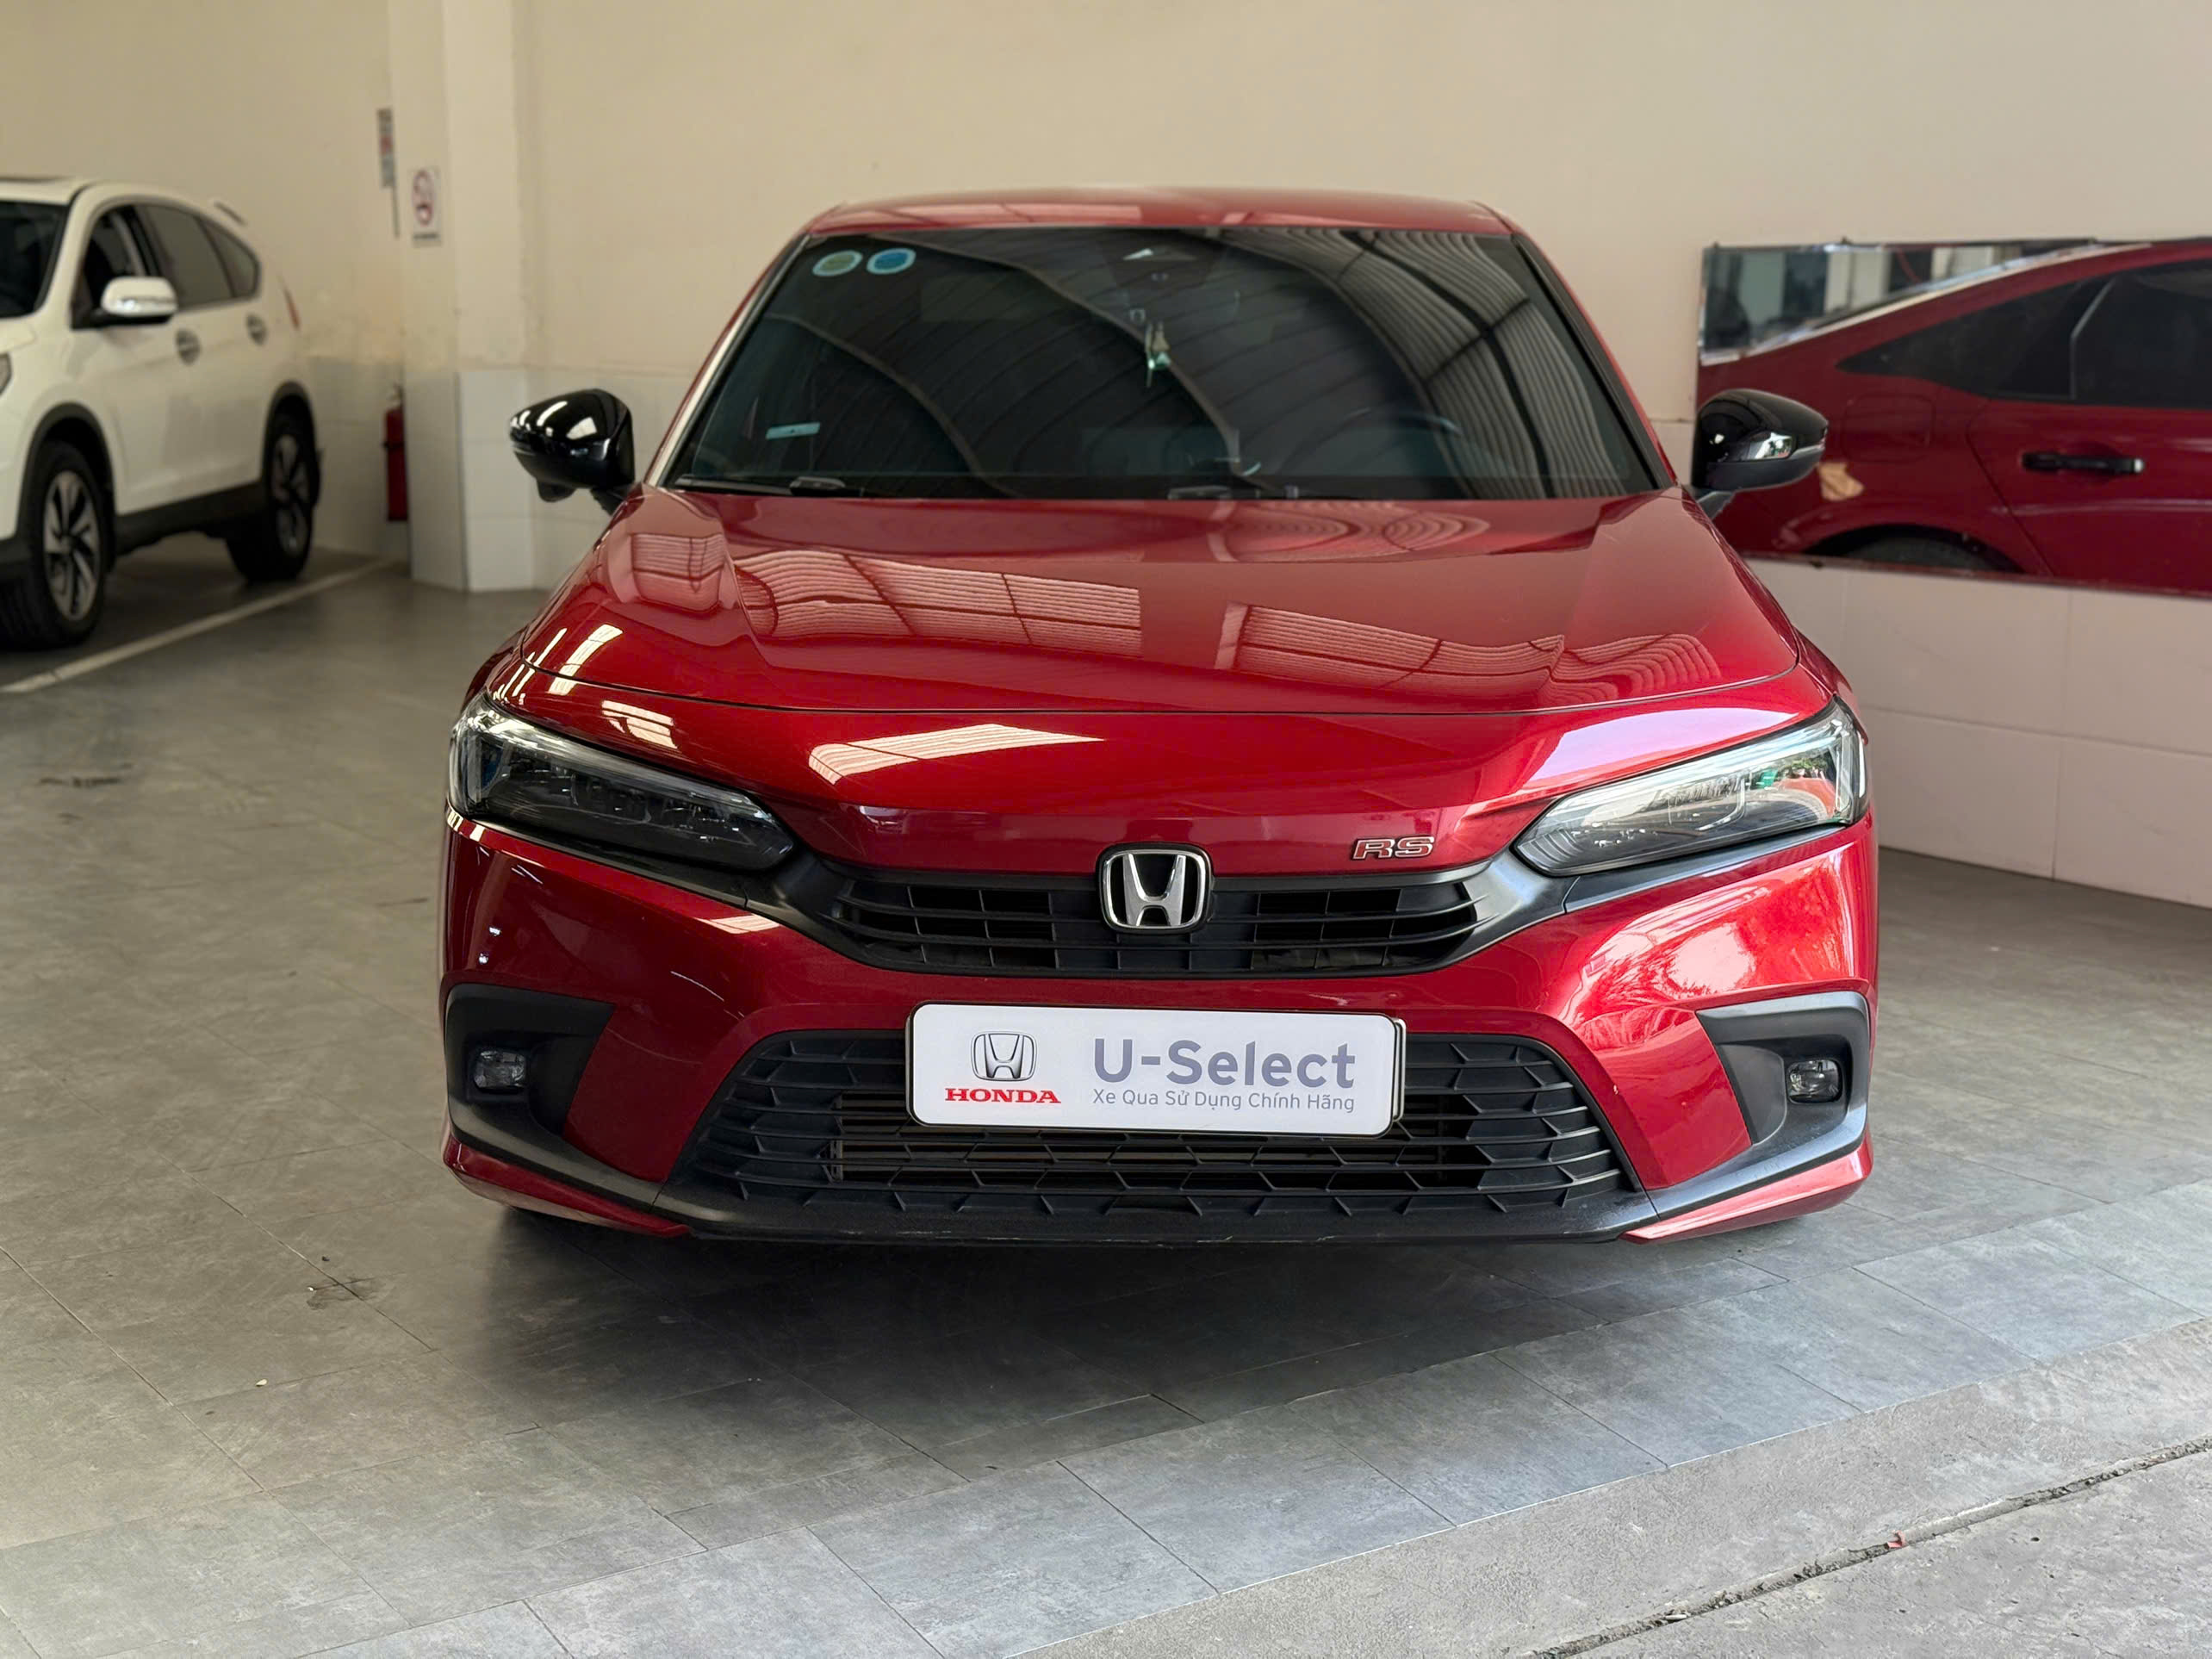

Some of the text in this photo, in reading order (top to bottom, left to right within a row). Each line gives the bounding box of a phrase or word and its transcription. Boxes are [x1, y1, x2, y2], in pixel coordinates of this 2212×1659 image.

[1351, 836, 1436, 860] RS
[1094, 1038, 1356, 1089] U-Select
[945, 1088, 1061, 1103] HONDA
[1093, 1089, 1354, 1113] Xe Qua Sử Dụng Chính Hãng
